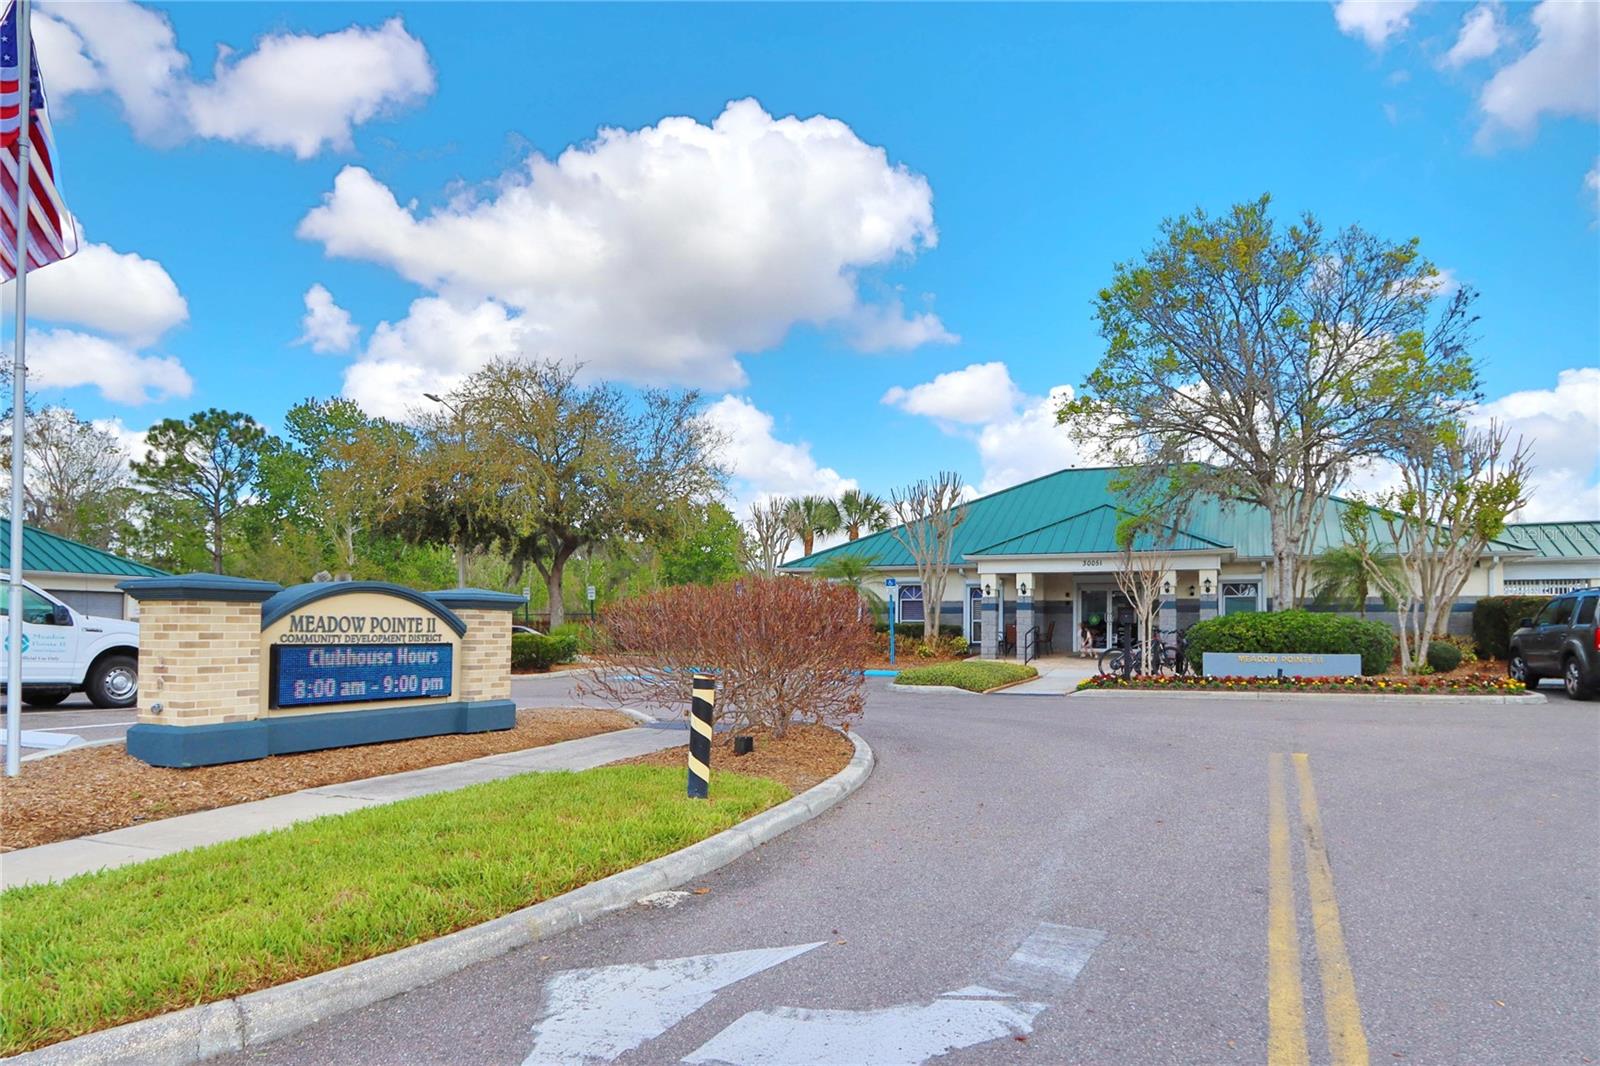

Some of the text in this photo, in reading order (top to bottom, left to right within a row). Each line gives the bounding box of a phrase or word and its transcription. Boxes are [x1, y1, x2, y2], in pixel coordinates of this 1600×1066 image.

[289, 615, 437, 633] MEADOW POINTE II
[280, 633, 442, 643] COMMUNITY DEVELOPMENT DISTRICT
[308, 647, 439, 666] Clubhouse Hours
[1238, 655, 1277, 664] MEADOW
[294, 678, 336, 698] 8:00
[340, 680, 366, 696] am
[383, 674, 418, 693] 9:00
[421, 676, 444, 695] pm
